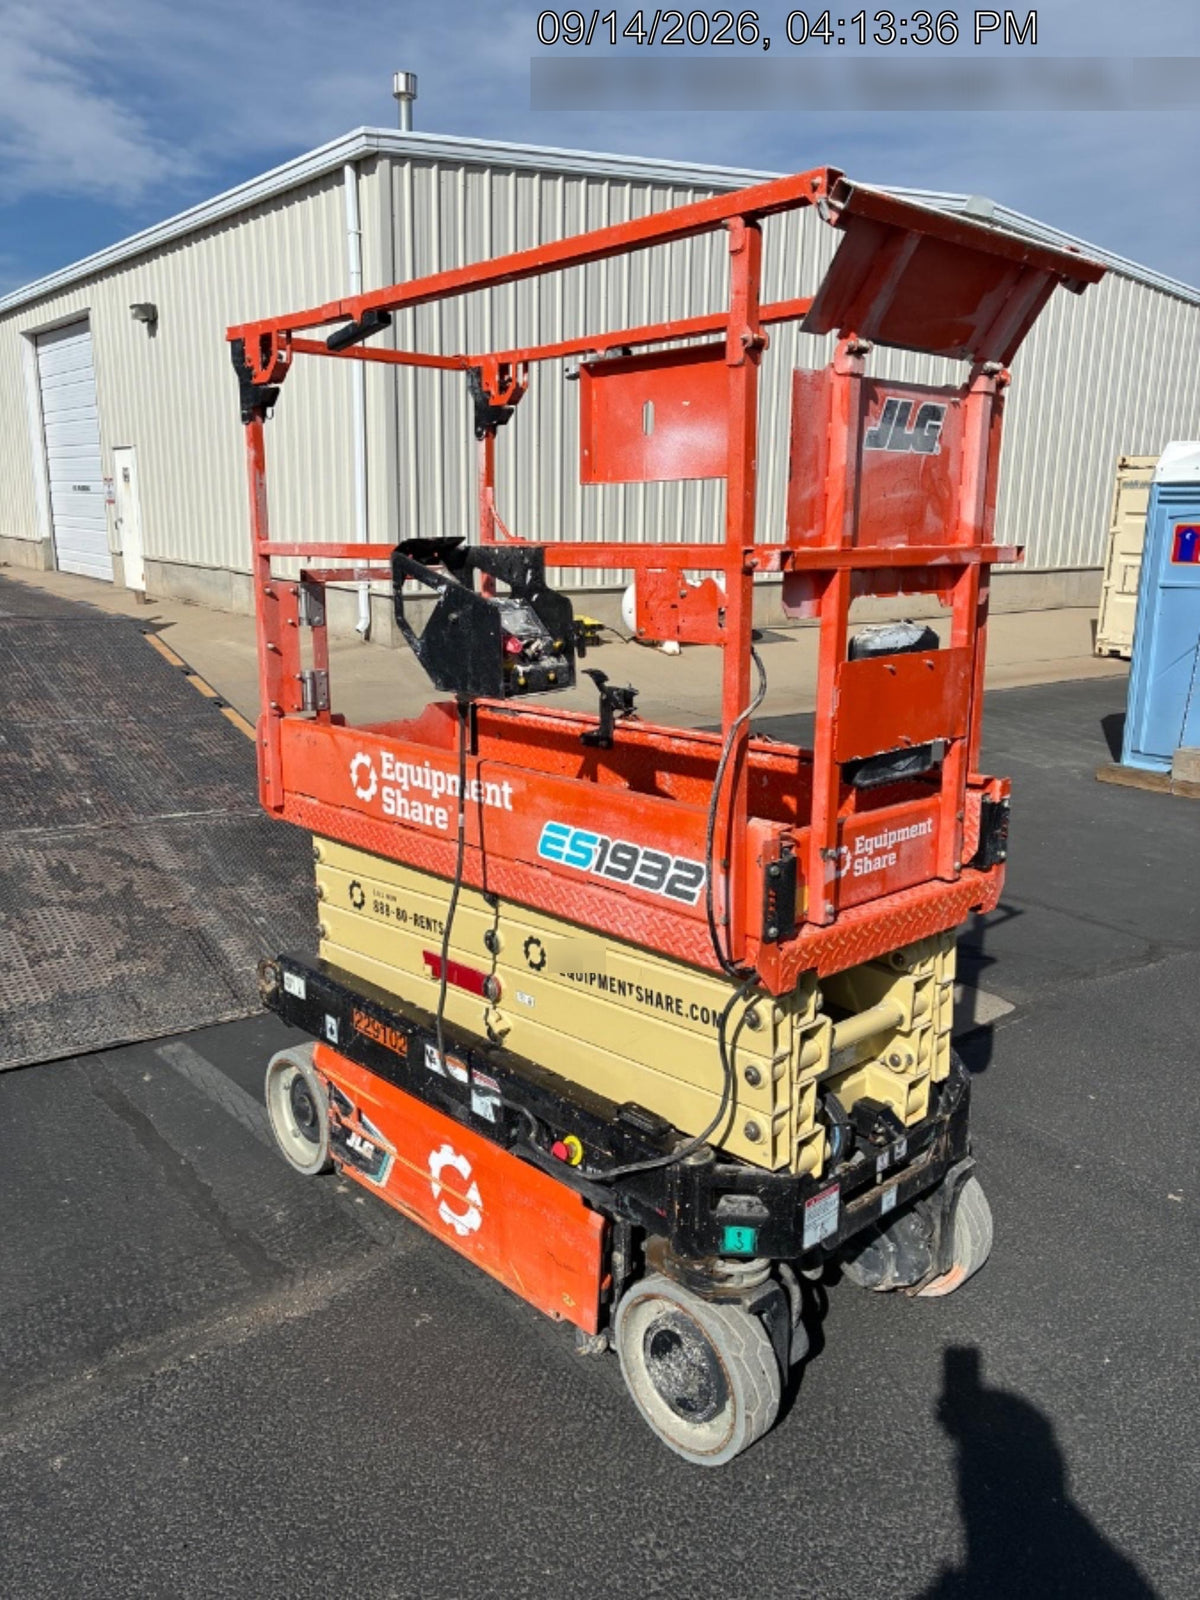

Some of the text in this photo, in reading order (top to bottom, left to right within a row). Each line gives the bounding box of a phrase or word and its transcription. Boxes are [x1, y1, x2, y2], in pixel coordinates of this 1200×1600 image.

[863, 396, 948, 455] JLG
[380, 750, 513, 811] Equipment
[381, 785, 449, 830] Share
[854, 817, 933, 855] Equipment
[538, 820, 707, 906] ES1932
[853, 852, 897, 877] Share
[373, 899, 445, 936] 888-80-RENTS
[559, 972, 722, 1028] QUIPMENTSHARE.COM
